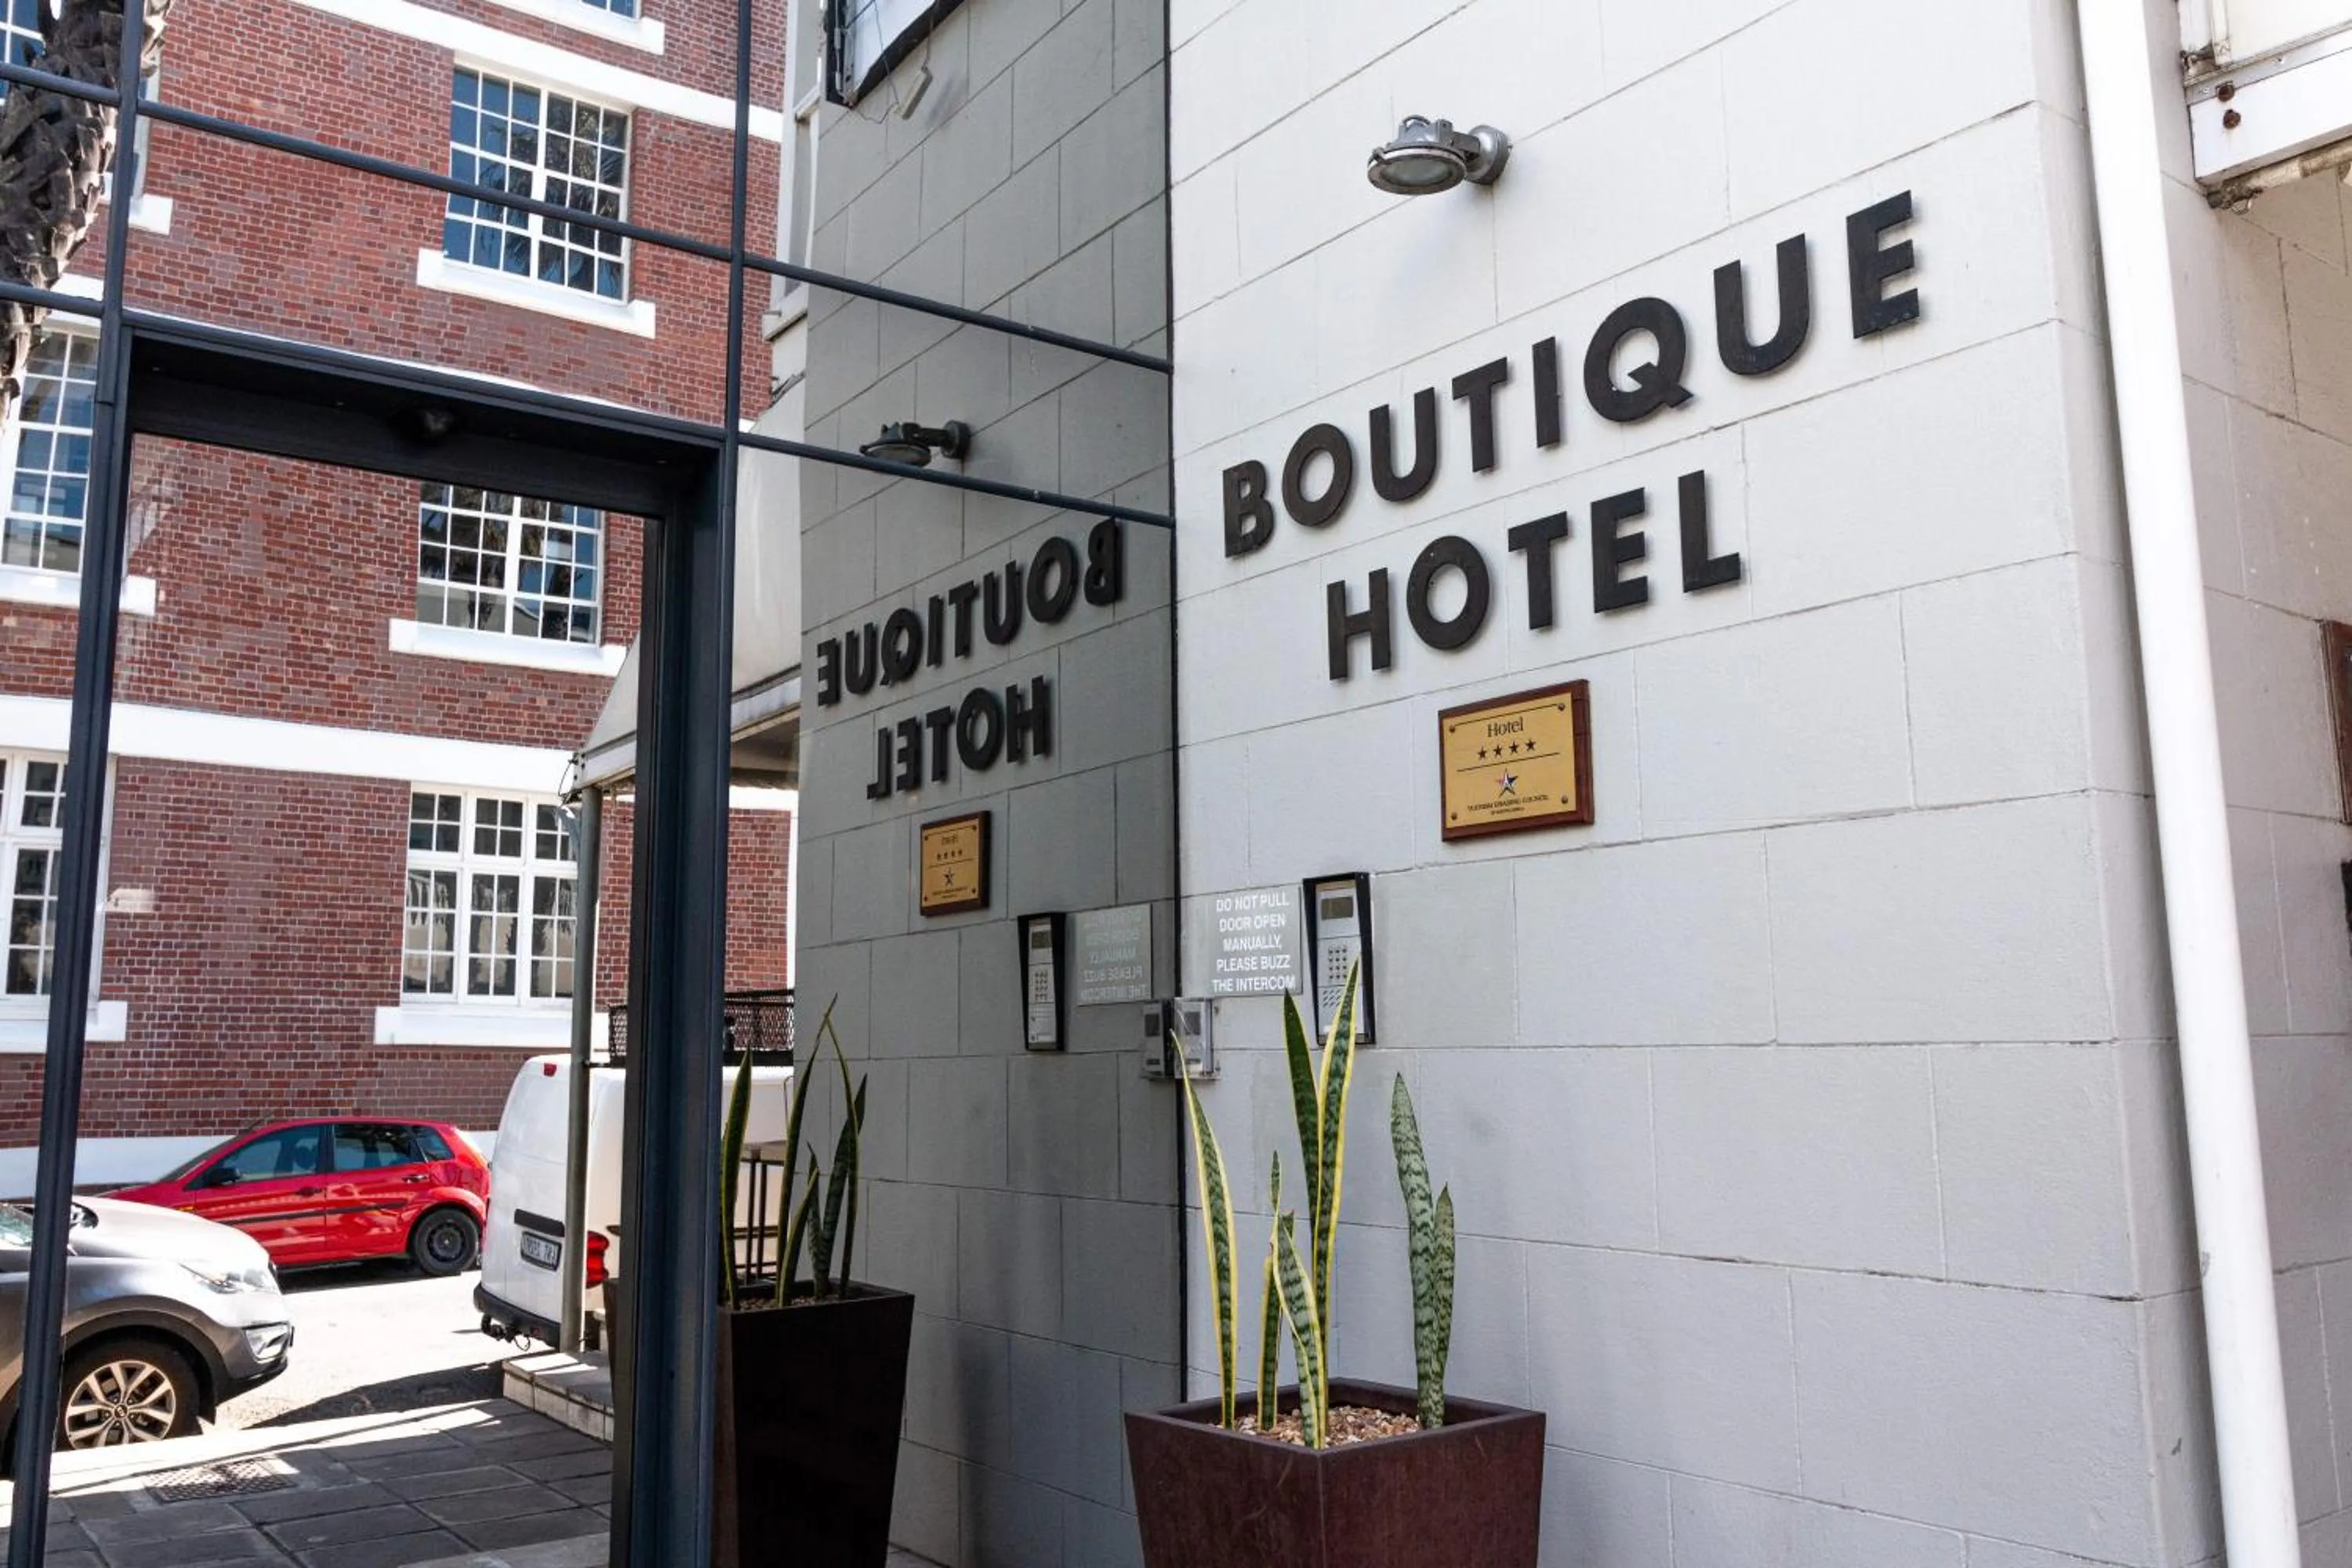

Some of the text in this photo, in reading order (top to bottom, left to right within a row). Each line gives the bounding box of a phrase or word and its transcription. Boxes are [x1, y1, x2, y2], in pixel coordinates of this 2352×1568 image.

[1222, 190, 1920, 558] BOUTIQUE
[1327, 470, 1740, 680] HOTEL
[1487, 717, 1523, 737] Hotel
[1216, 891, 1289, 912] DO NOT PULL
[1219, 913, 1286, 932] DOOR OPEN
[1216, 954, 1291, 972] PLEASE BUZZ
[1211, 974, 1296, 993] THE INTERCOM
